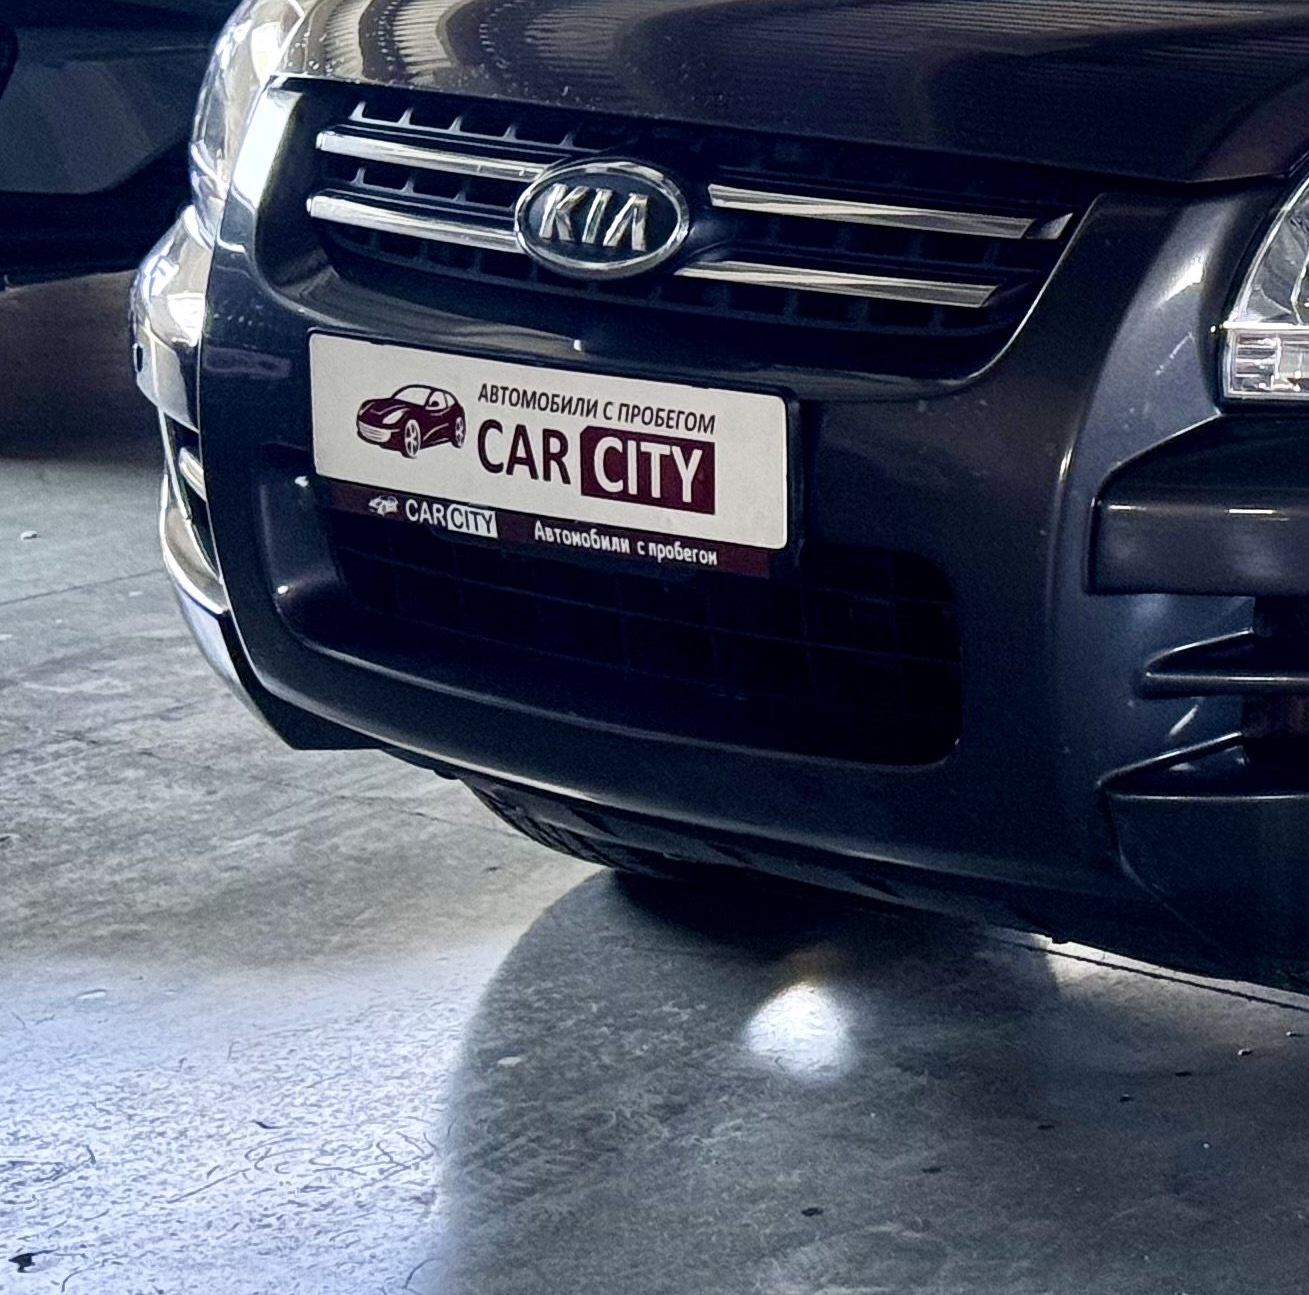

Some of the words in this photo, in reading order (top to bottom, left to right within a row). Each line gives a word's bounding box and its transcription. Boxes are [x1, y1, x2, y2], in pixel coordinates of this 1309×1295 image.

[538, 183, 649, 252] KIA
[478, 383, 599, 420] АВТОМОБИЛИ
[602, 401, 613, 421] С
[617, 402, 717, 436] ПРОБЕГОМ
[477, 418, 572, 485] CAR
[593, 436, 703, 504] CITY
[405, 498, 447, 528] CAR
[449, 506, 495, 535] CITY
[533, 520, 631, 554] Автомобили
[636, 541, 645, 556] с
[648, 542, 718, 566] пробегом
